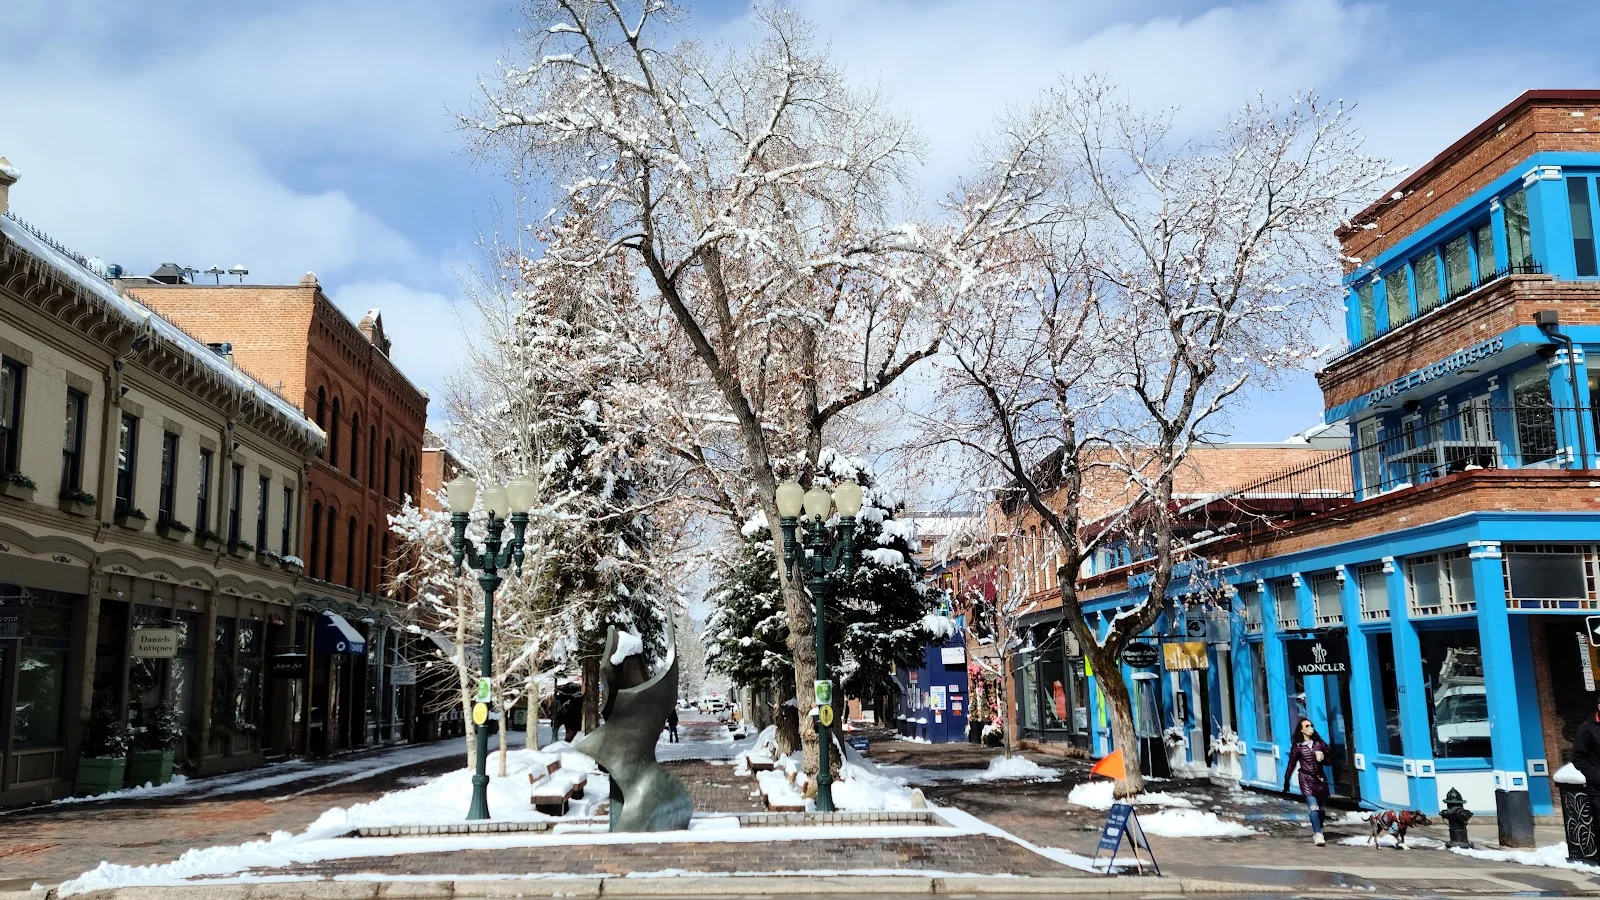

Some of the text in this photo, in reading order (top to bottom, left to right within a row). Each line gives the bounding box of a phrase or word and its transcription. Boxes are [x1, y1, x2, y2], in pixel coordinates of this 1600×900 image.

[1367, 384, 1399, 405] ZONE
[1419, 338, 1503, 383] ARCHITECTS
[140, 635, 170, 643] Daniels
[137, 644, 173, 654] Antiques
[1298, 663, 1346, 673] MONCLER
